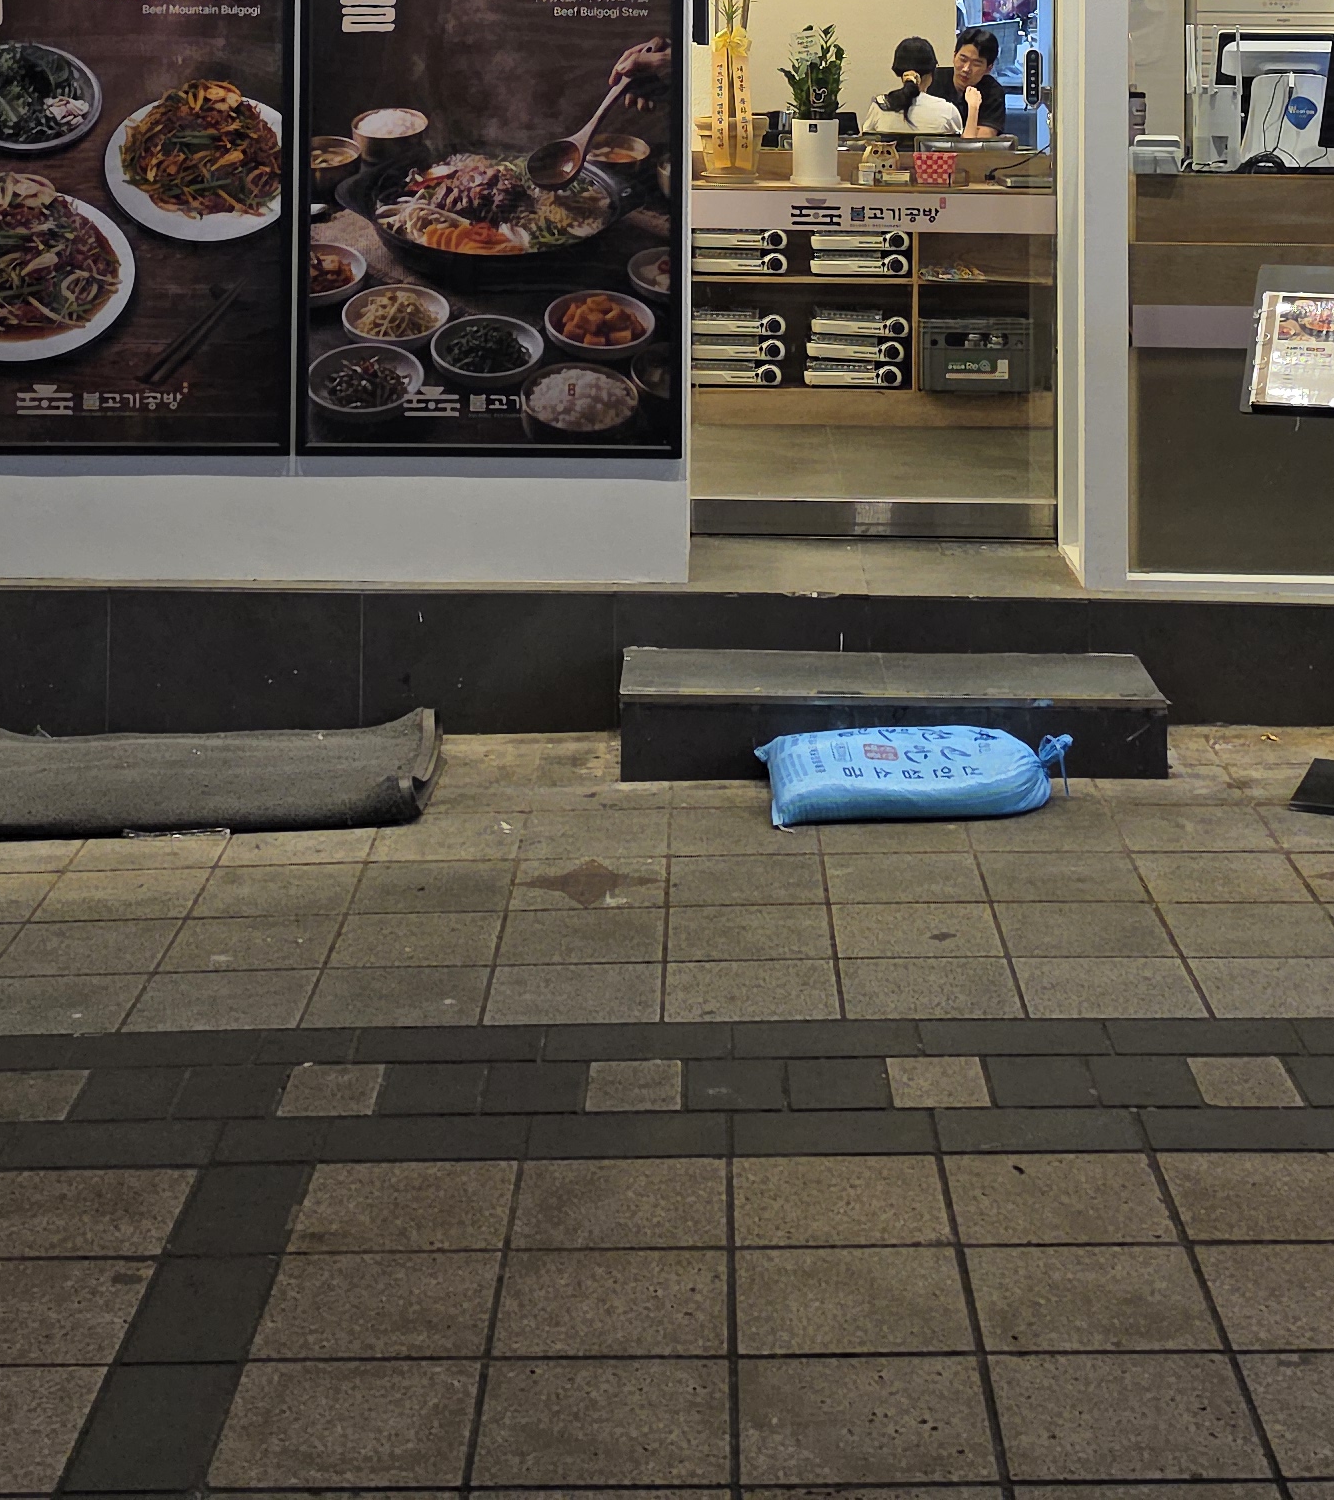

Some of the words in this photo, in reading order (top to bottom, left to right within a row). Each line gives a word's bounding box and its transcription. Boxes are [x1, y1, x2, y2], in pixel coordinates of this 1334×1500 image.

[142, 4, 167, 15] Beef
[168, 4, 219, 15] Mountain
[220, 4, 261, 17] Bulgogi
[553, 6, 578, 17] Beef
[580, 6, 620, 19] Bulgogi
[621, 7, 649, 17] Stew
[850, 206, 940, 224] 불고기공방
[82, 391, 183, 410] 불고기공방
